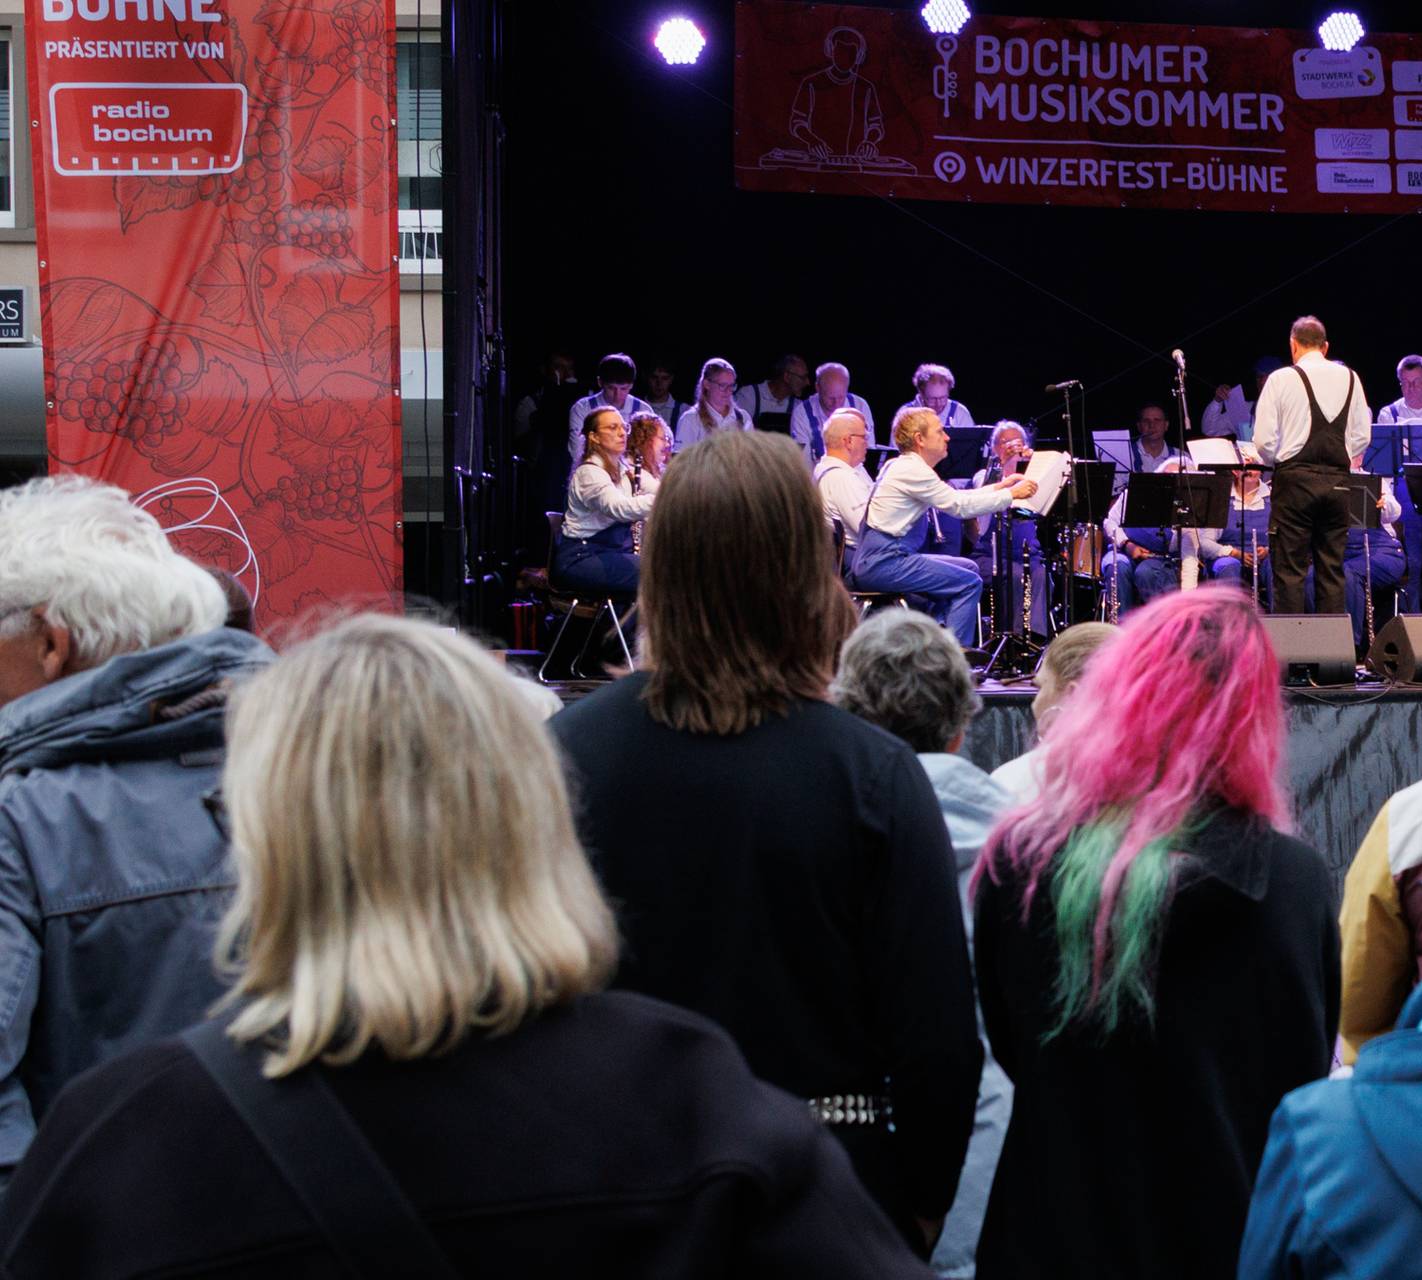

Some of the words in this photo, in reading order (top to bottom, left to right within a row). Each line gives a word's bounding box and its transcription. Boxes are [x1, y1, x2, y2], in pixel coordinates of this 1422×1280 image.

[45, 37, 179, 59] PRÄSENTIERT
[183, 41, 225, 60] VON
[975, 35, 1209, 84] BOCHUMER
[91, 101, 170, 119] radio
[974, 82, 1285, 132] MUSIKSOMMER
[93, 124, 213, 142] bochum
[976, 156, 1288, 193] WINZERFEST-BÜHNE
